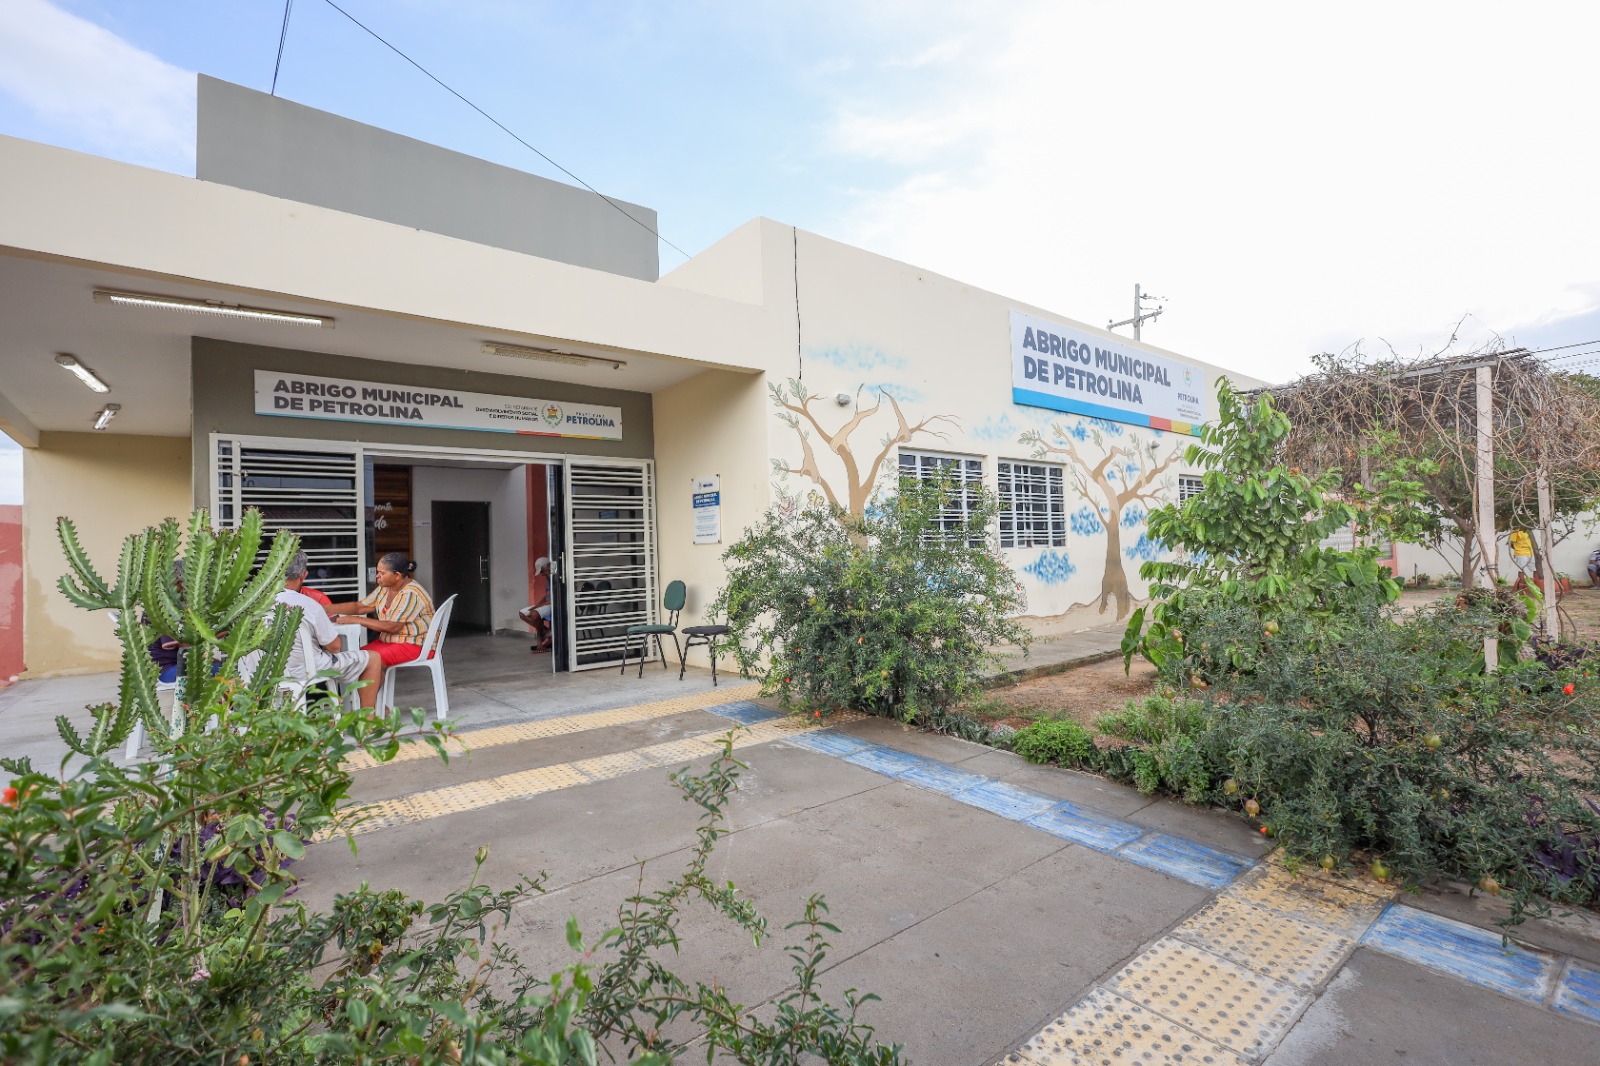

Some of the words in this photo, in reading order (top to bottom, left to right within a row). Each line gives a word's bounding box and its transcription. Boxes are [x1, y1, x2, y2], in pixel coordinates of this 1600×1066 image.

[1023, 326, 1091, 365] ABRIGO
[1095, 347, 1171, 387] MUNICIPAL
[273, 379, 356, 399] ABRIGO
[362, 387, 464, 409] MUNICIPAL
[1024, 355, 1050, 383] DE
[1053, 362, 1143, 404] PETROLINA
[274, 396, 303, 411] DE
[309, 398, 423, 421] PETROLINA
[566, 415, 615, 427] PETROLINA
